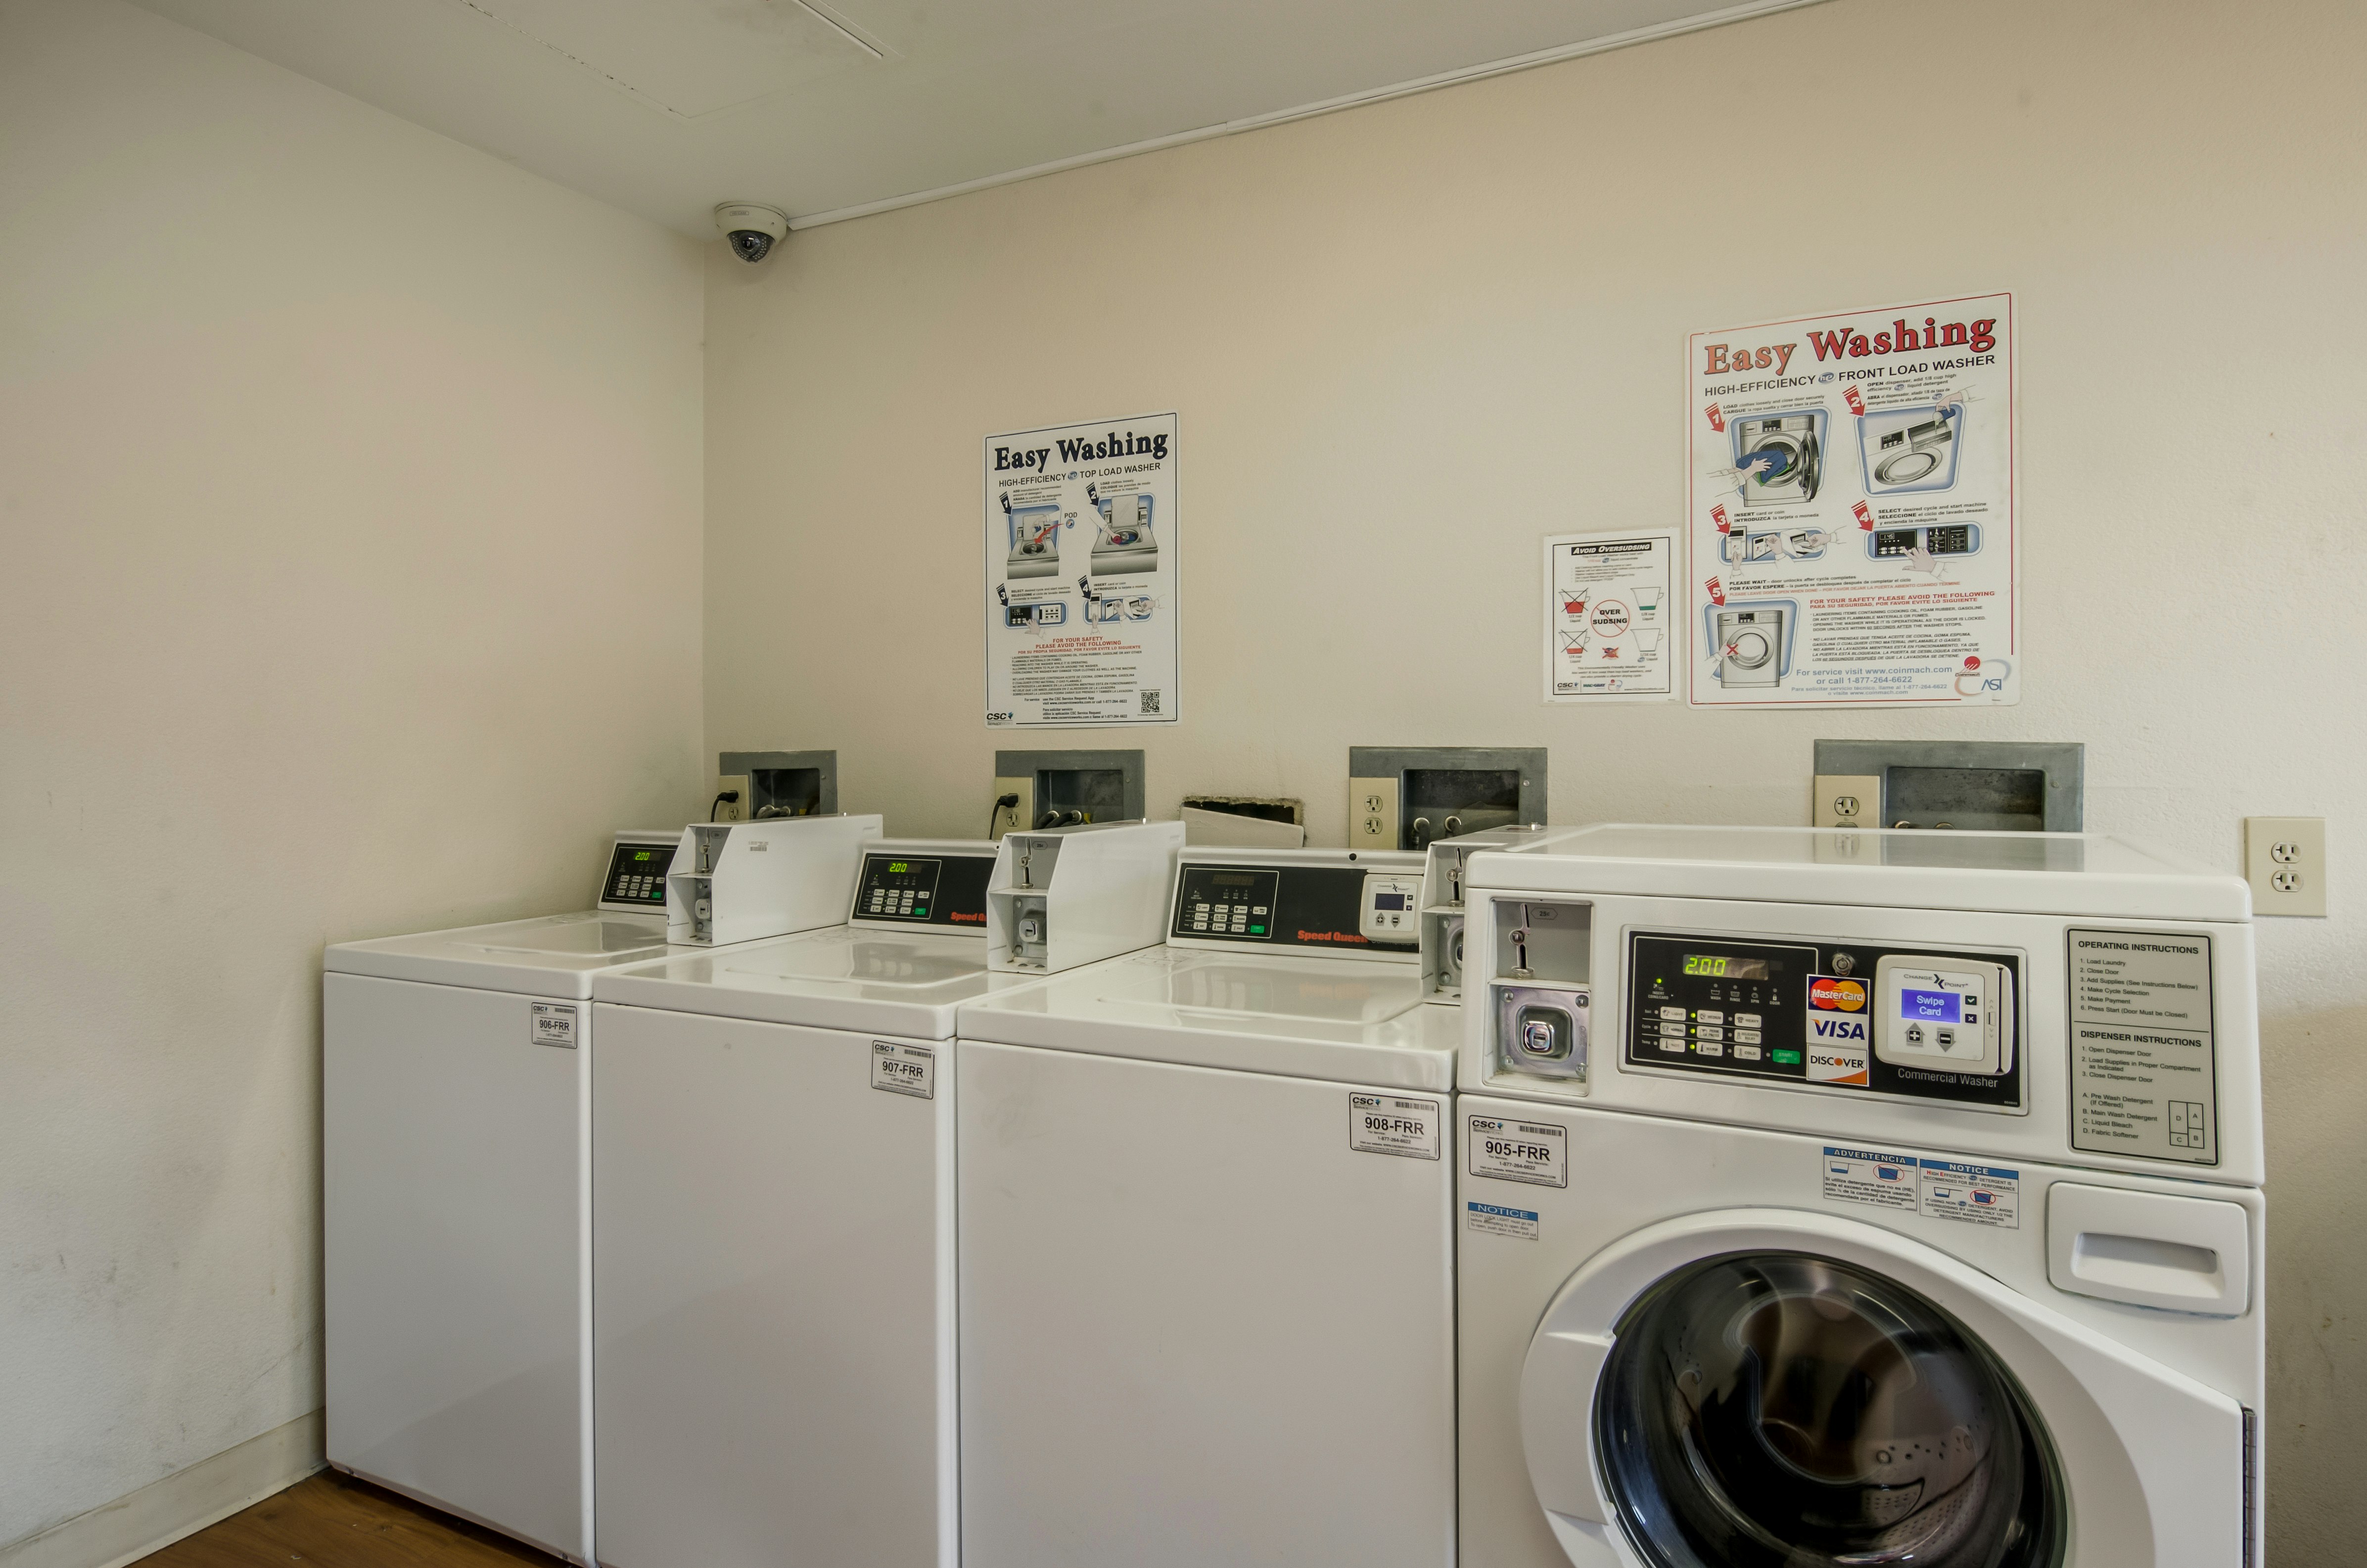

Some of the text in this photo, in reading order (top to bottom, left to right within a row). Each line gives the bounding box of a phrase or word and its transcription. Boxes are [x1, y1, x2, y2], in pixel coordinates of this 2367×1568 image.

[1704, 318, 1996, 376] Easy Washing
[1705, 375, 1816, 396] HIGH-EFFICIENCY
[1839, 368, 1885, 381] FRONT
[1889, 363, 1928, 376] LOAD
[1933, 355, 1996, 370] WASHER
[1851, 396, 1860, 408] 2
[1712, 414, 1719, 424] 1
[994, 431, 1168, 473] Easy Washing
[999, 462, 1160, 487] HIGH-EFFICIENCY TOP LOAD WASHER
[1717, 514, 1726, 525] 3
[1859, 511, 1870, 522] 4
[1001, 592, 1006, 600] 3
[1713, 588, 1720, 598] 5
[635, 852, 650, 861] 2.00
[889, 863, 908, 872] 2.00
[951, 912, 977, 921] Speed
[1298, 930, 1369, 943] Speed Queen
[2078, 940, 2198, 954] OPERATING INSTRUCTIONS
[1685, 957, 1726, 976] 2.00
[2177, 982, 2198, 991] Below)
[1811, 989, 1864, 1002] MasterCard
[1916, 995, 1945, 1007] Swipe
[1919, 1006, 1942, 1016] Card
[2164, 1011, 2187, 1019] Closed)
[539, 1019, 569, 1031] 906-FRR
[1811, 1018, 1865, 1040] VISA
[2080, 1030, 2201, 1047] DISPENSER INSTRUCTIONS
[2105, 1047, 2135, 1056] Dispenser
[1810, 1055, 1864, 1068] DISCOVER
[2088, 1057, 2103, 1065] Load
[2104, 1058, 2130, 1067] Supplies
[2159, 1063, 2201, 1072] Compartment
[882, 1061, 923, 1078] 907-FRR
[1898, 1068, 1998, 1088] Commercial Washer
[2107, 1073, 2137, 1081] Dispenser
[1352, 1097, 1374, 1105] CSC
[2090, 1093, 2102, 1101] Pre
[2122, 1096, 2153, 1105] Detergent
[2097, 1100, 2123, 1109] Offered)
[2126, 1112, 2157, 1121] Detergent
[1365, 1117, 1424, 1135] 908-FRR
[1472, 1120, 1495, 1129] CSC
[1378, 1136, 1411, 1144] 1-877-264-6622
[1485, 1141, 1550, 1161] 905-FRR
[1834, 1149, 1905, 1163] ADVERTENCIA
[1499, 1161, 1535, 1170] 1-877-264-6622
[1949, 1164, 1989, 1175] NOTICE
[1478, 1204, 1529, 1219] NOTICE
